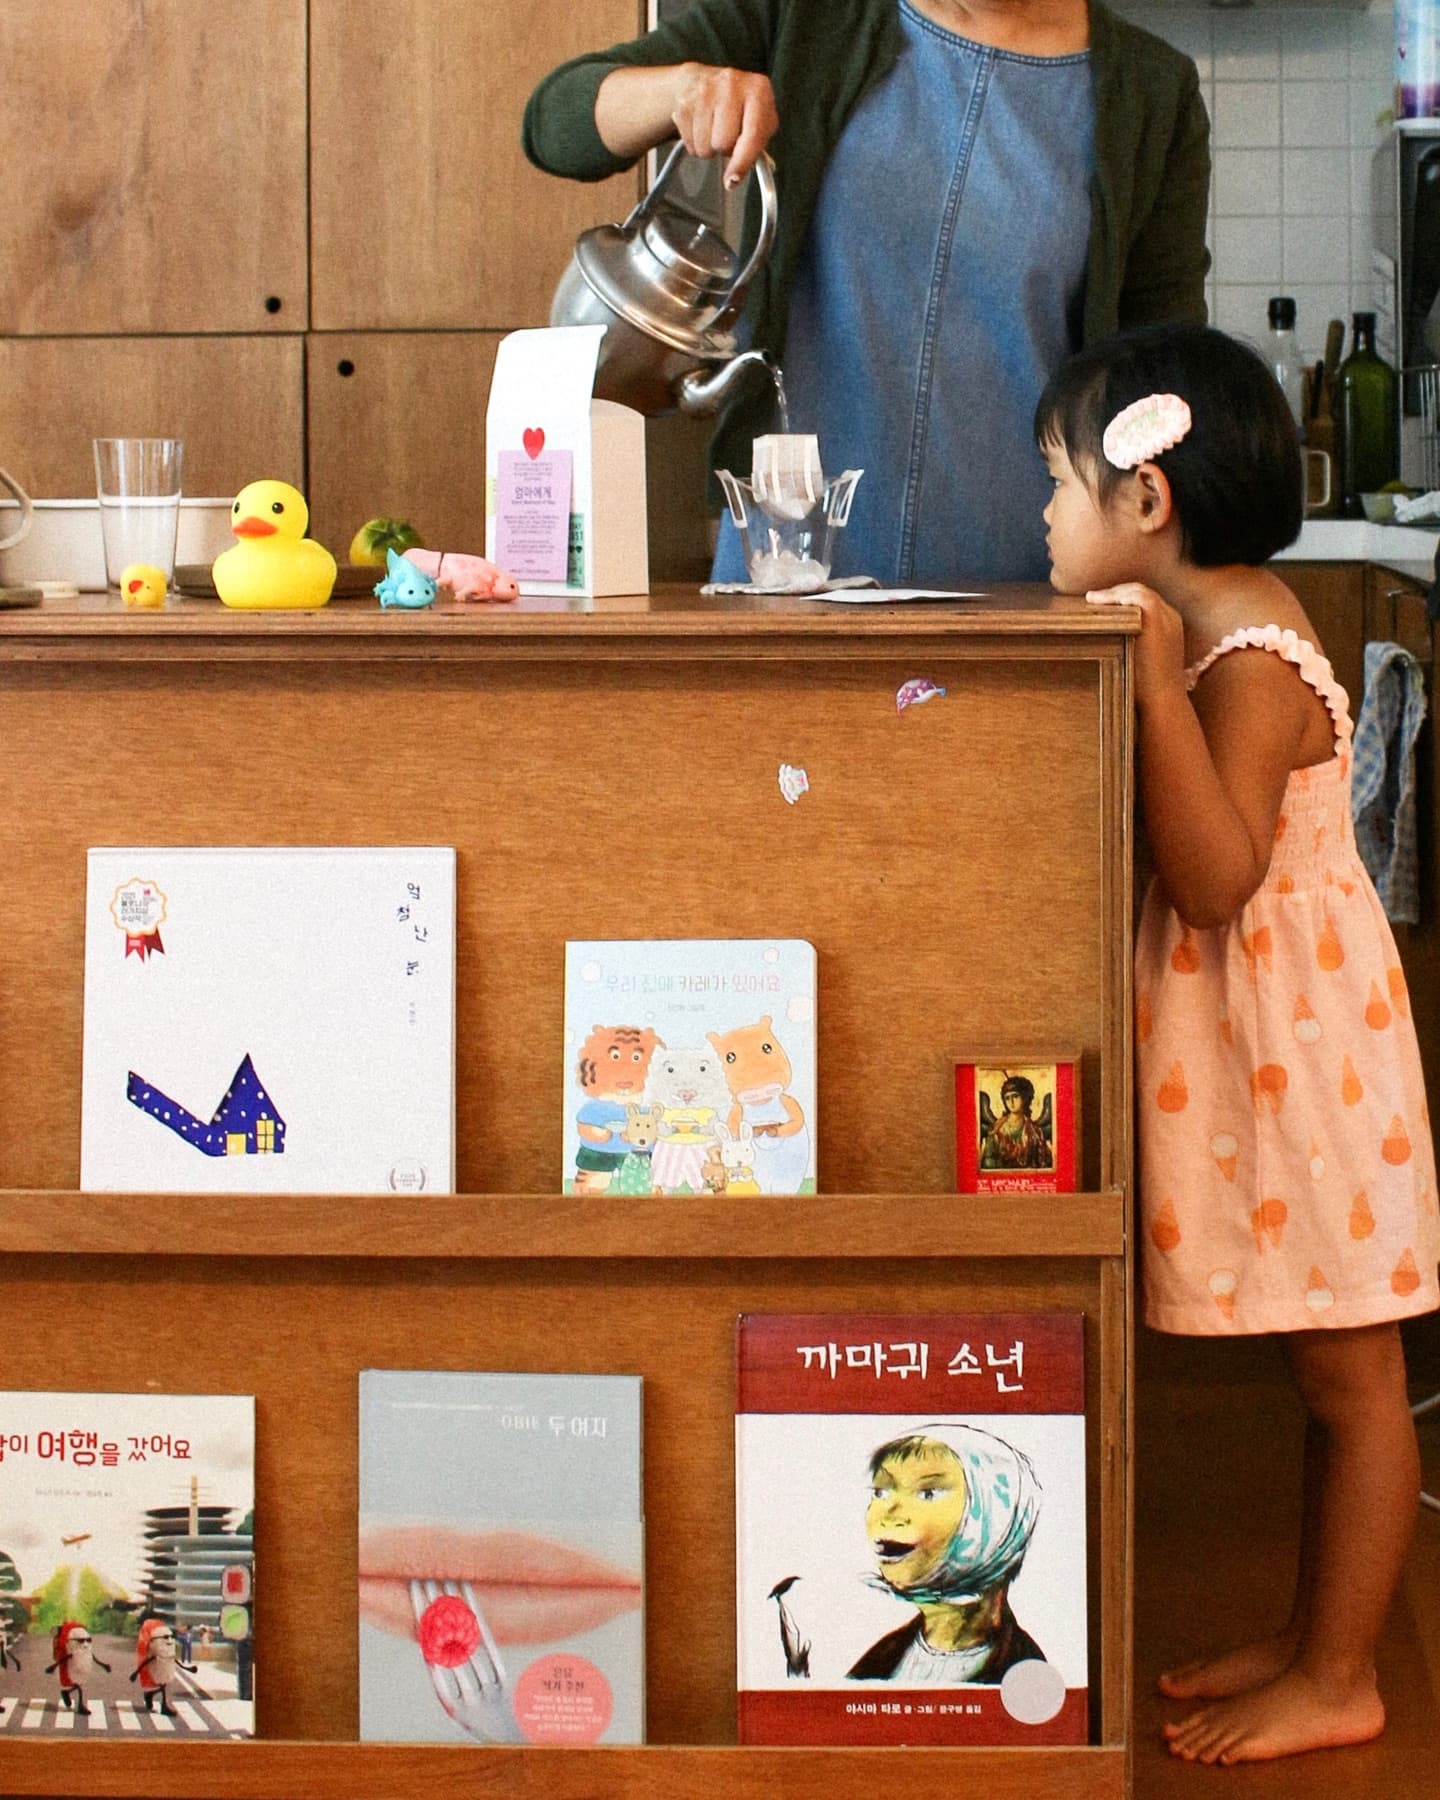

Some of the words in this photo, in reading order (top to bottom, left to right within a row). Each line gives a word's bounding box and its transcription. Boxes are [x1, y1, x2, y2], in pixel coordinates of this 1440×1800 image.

[607, 976, 636, 992] 우리
[679, 975, 727, 993] 카레가
[732, 975, 780, 993] 있어요
[796, 1341, 929, 1380] 까마귀
[947, 1340, 1024, 1393] 소년
[37, 1430, 120, 1467] 여행을
[128, 1434, 192, 1462] 갔어요
